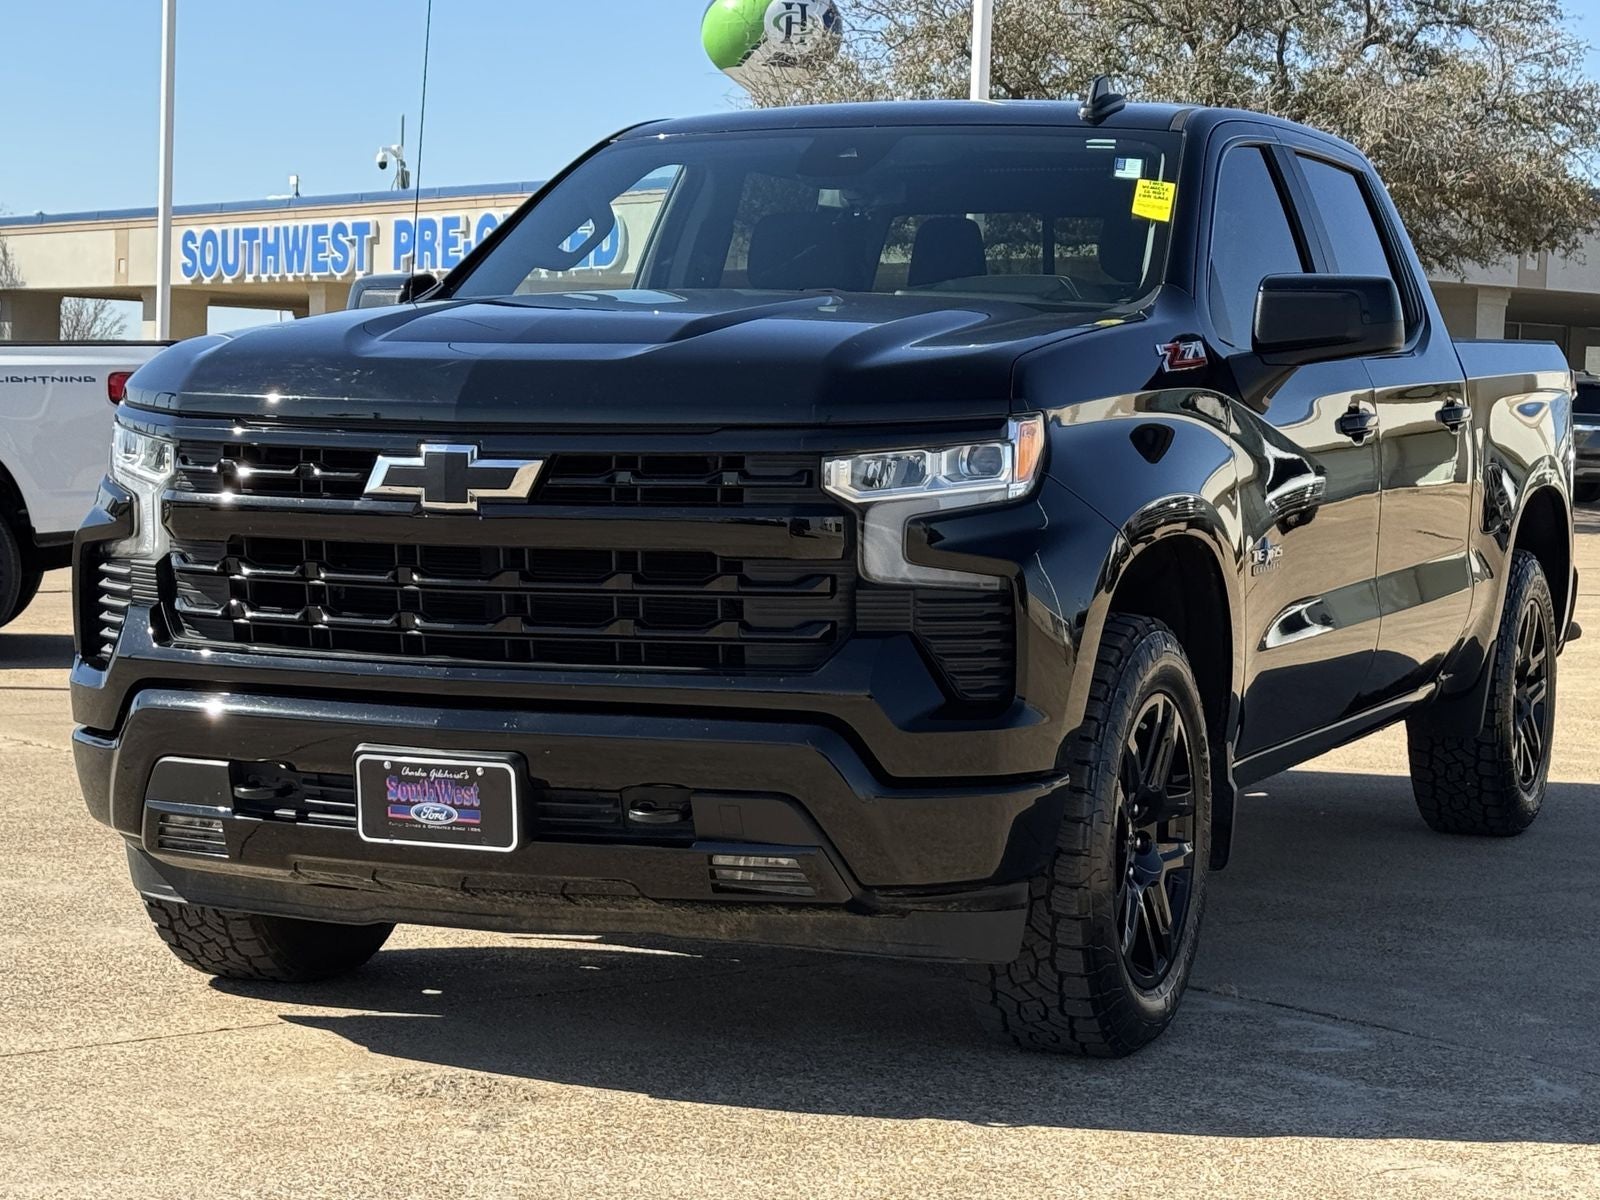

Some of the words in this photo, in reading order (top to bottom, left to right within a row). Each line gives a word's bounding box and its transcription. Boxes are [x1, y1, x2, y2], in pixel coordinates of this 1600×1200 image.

[181, 220, 372, 279] SOUTHWEST
[1155, 340, 1208, 373] Z71
[386, 774, 481, 807] SouthWest
[420, 806, 447, 821] Ford
